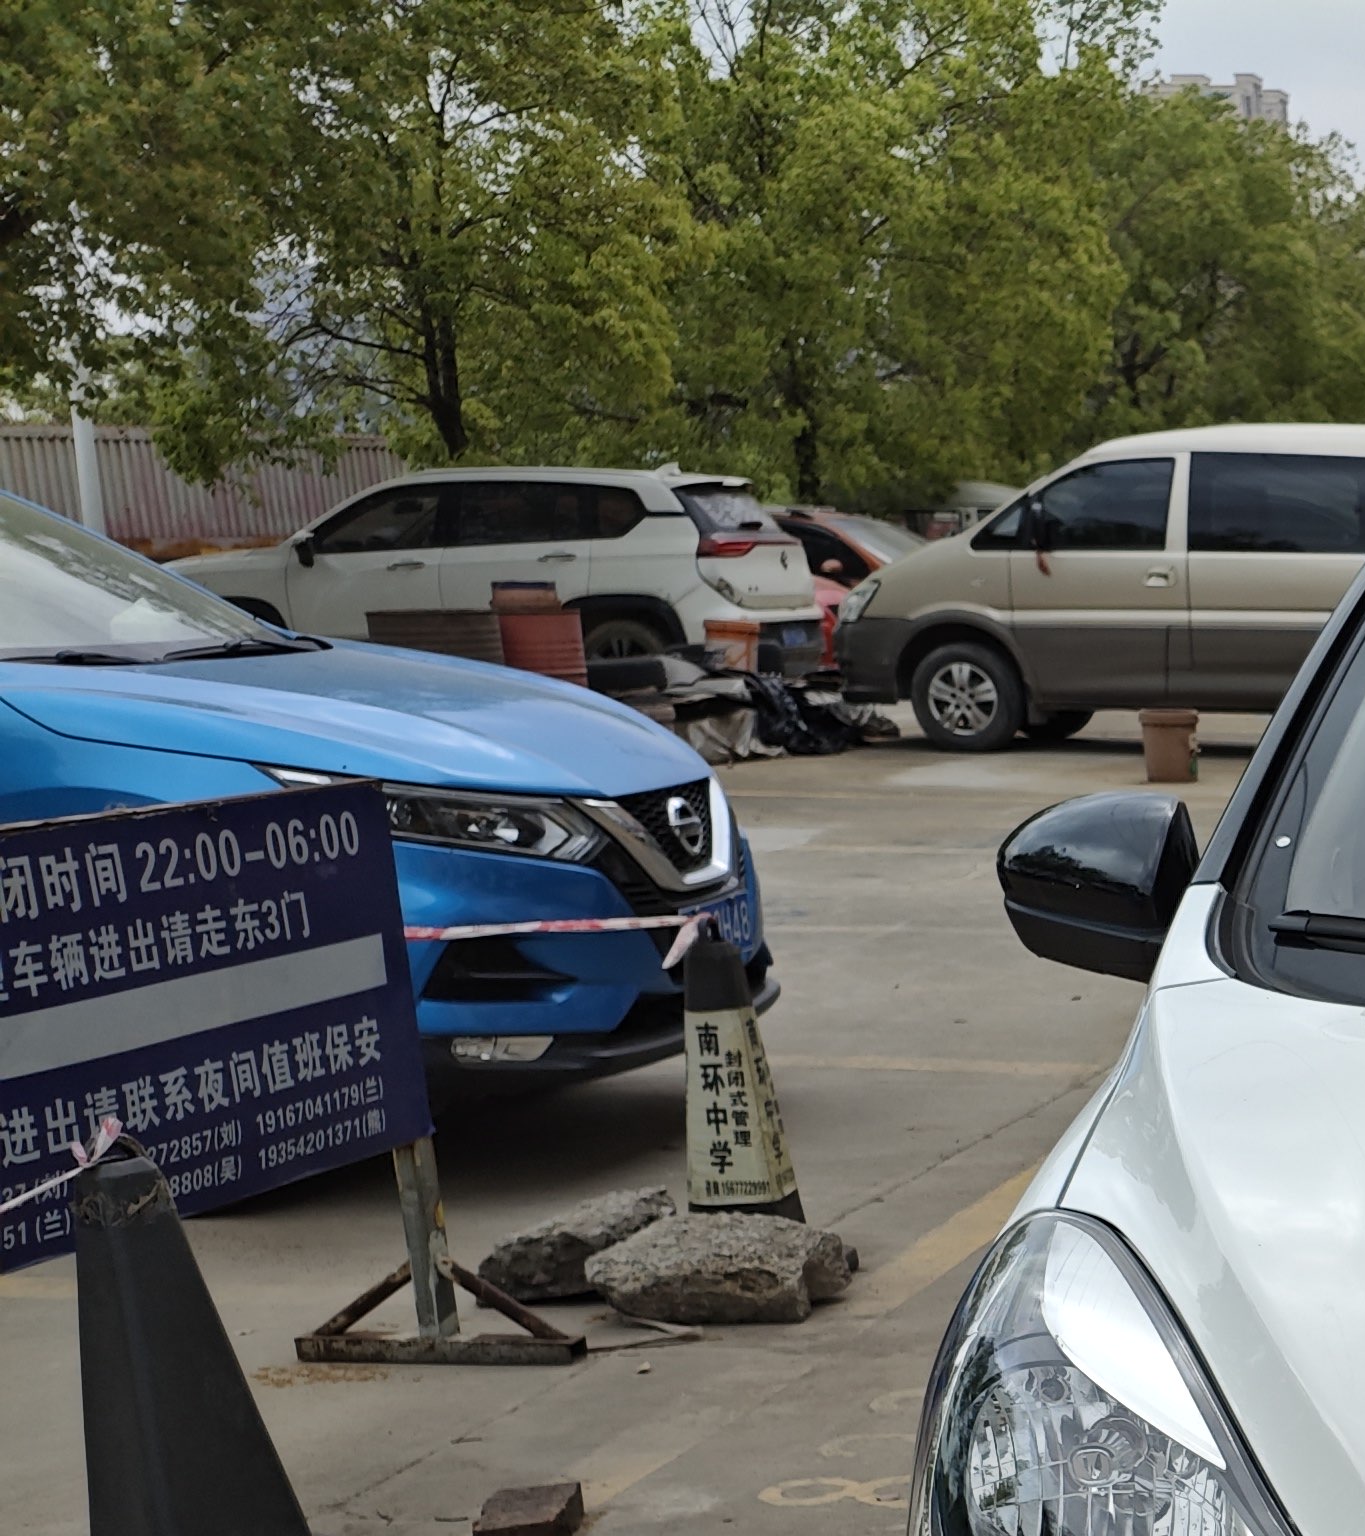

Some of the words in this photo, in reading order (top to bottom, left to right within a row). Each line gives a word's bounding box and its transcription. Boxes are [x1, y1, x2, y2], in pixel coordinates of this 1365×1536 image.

[0, 843, 127, 924] 闭时间
[135, 810, 360, 893] 22:00-06:00
[0, 890, 311, 1000] 车辆进出请走东3门
[0, 1015, 382, 1168] 进出请联系夜间值班保安
[148, 1119, 242, 1168] 272857(刘)
[255, 1075, 384, 1136] 19167041179(兰)
[696, 1021, 734, 1175] 南环中学
[725, 1048, 752, 1148] 封闭式管理
[170, 1154, 242, 1199] 8808(吴)
[258, 1108, 386, 1171] 19354201371(熊)
